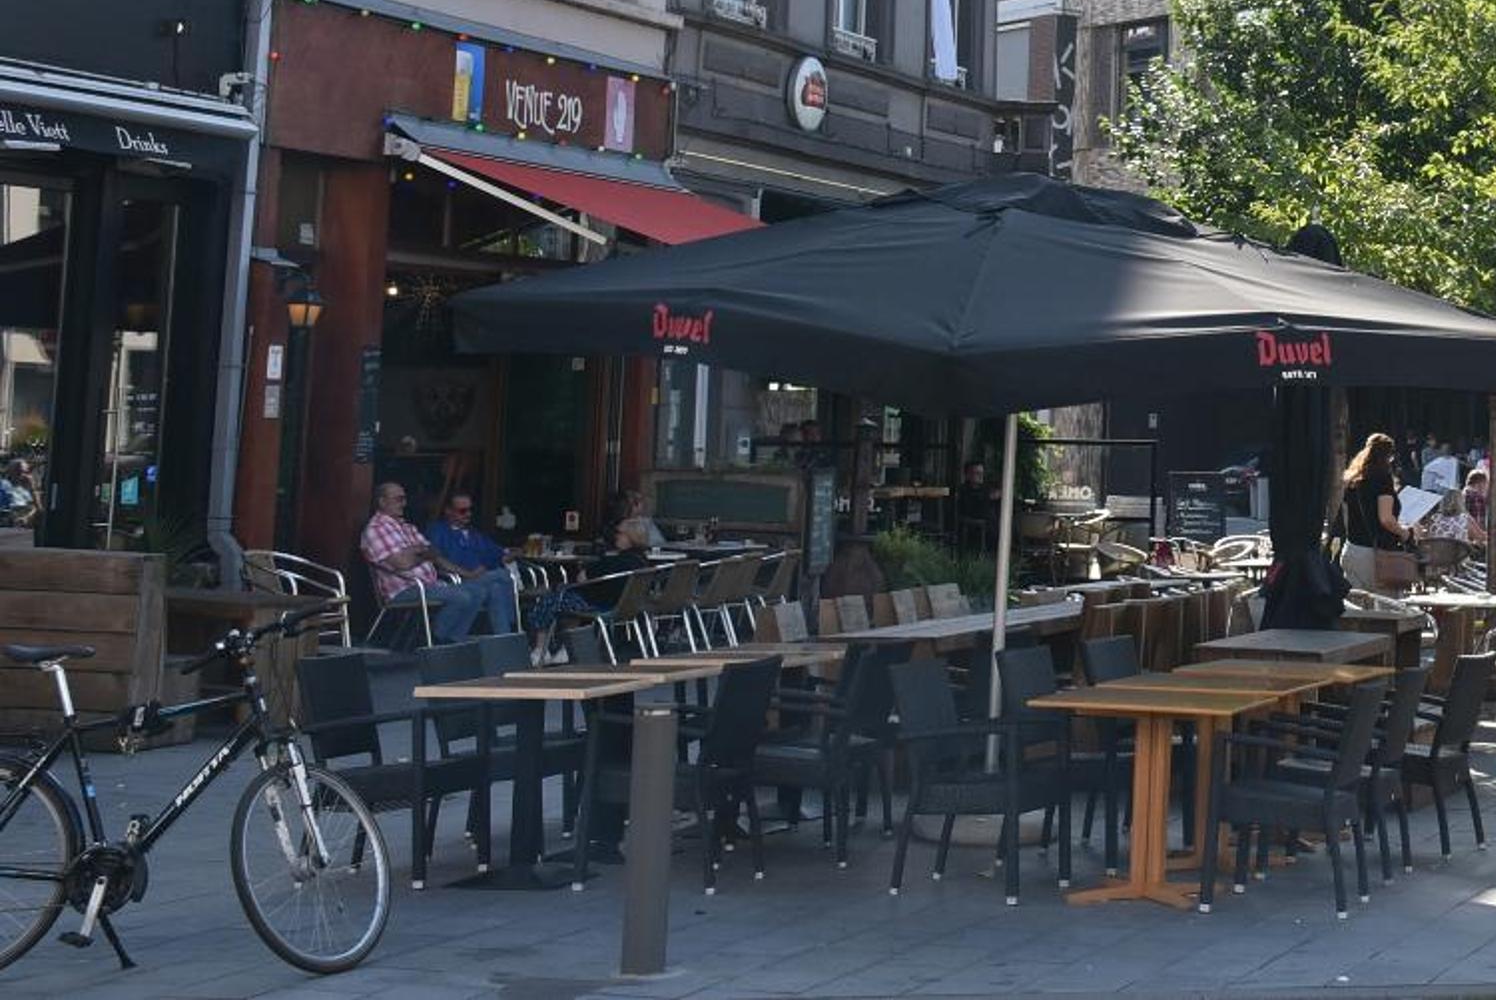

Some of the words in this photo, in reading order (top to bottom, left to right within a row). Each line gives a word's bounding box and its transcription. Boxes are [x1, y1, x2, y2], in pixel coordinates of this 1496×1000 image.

[506, 79, 555, 134] VENUE
[557, 94, 583, 134] 219
[115, 125, 168, 155] Drinks
[653, 303, 714, 345] Duvel
[1256, 330, 1332, 367] Duvel
